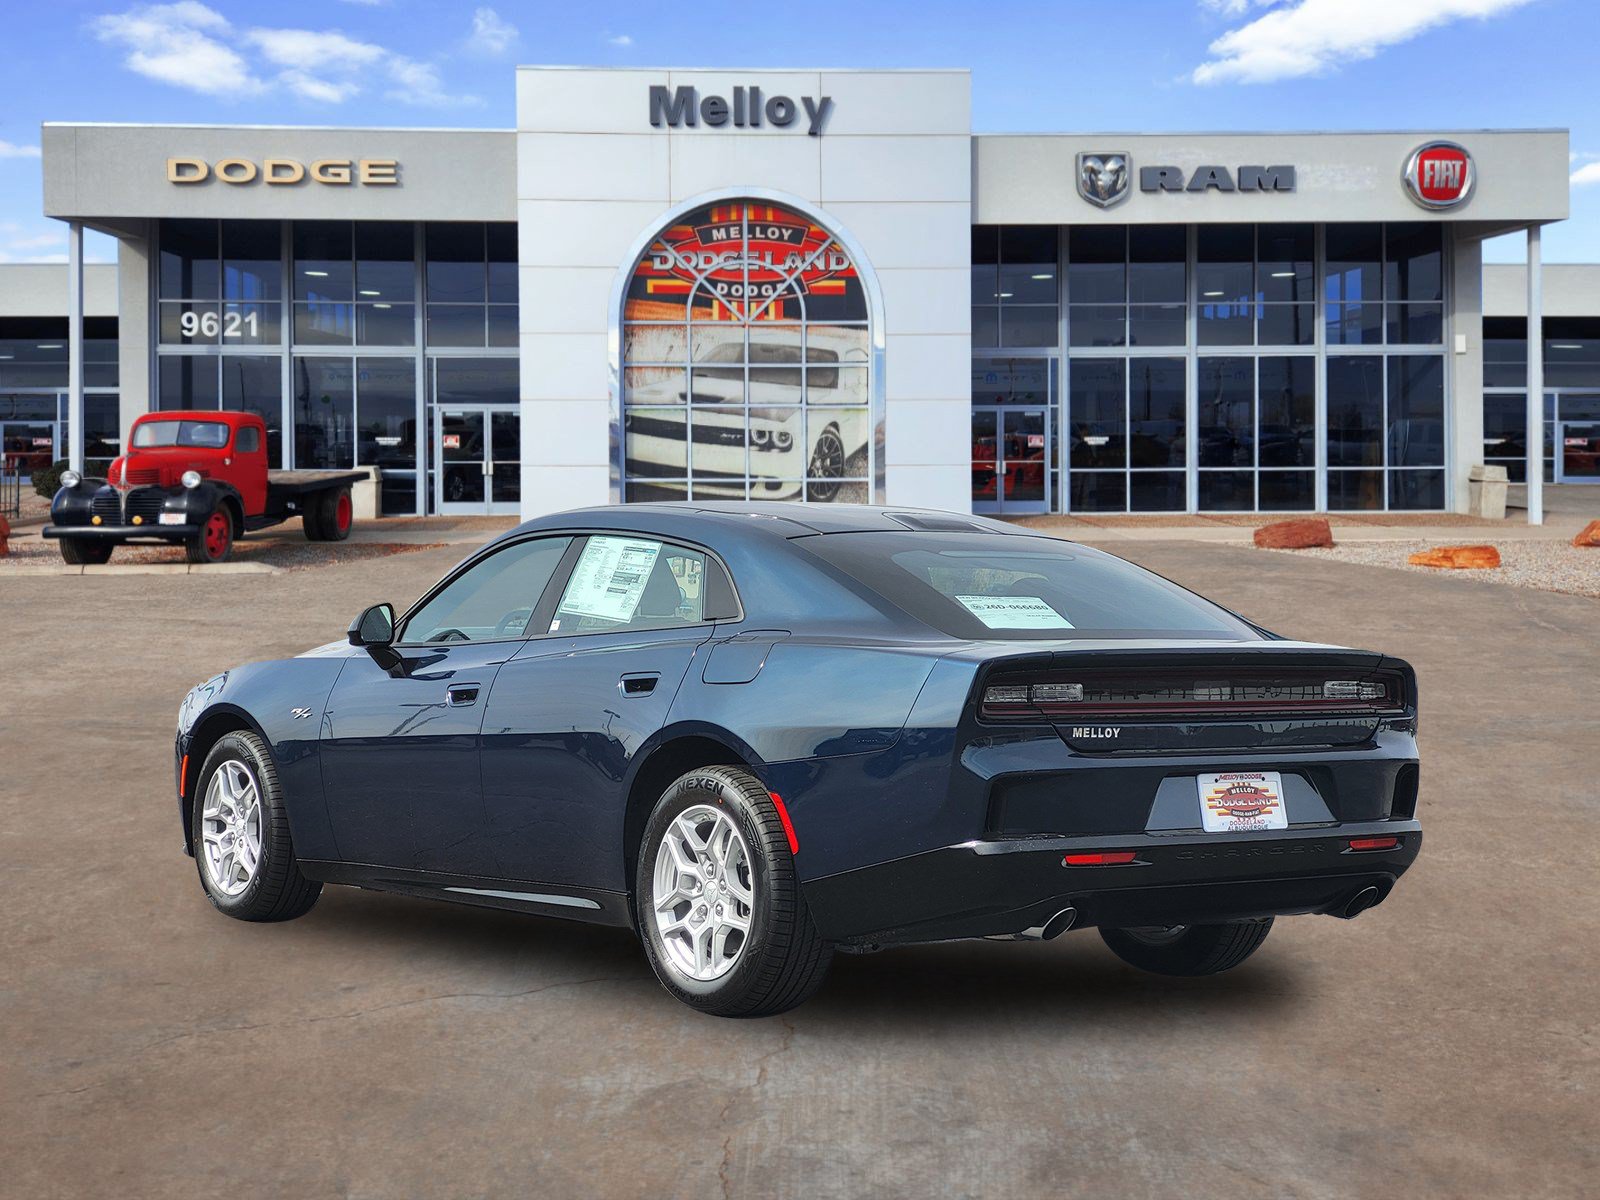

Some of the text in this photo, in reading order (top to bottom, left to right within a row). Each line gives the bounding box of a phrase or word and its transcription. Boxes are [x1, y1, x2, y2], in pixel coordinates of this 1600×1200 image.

[649, 85, 832, 136] Melloy
[166, 158, 399, 184] DODGE
[1139, 165, 1296, 191] RAM
[1423, 159, 1464, 189] FIAT
[711, 226, 793, 242] MELOY
[181, 311, 257, 337] 9621
[1072, 727, 1120, 738] MELLOY
[676, 777, 724, 796] NEXEN
[1230, 786, 1256, 795] MELLOY
